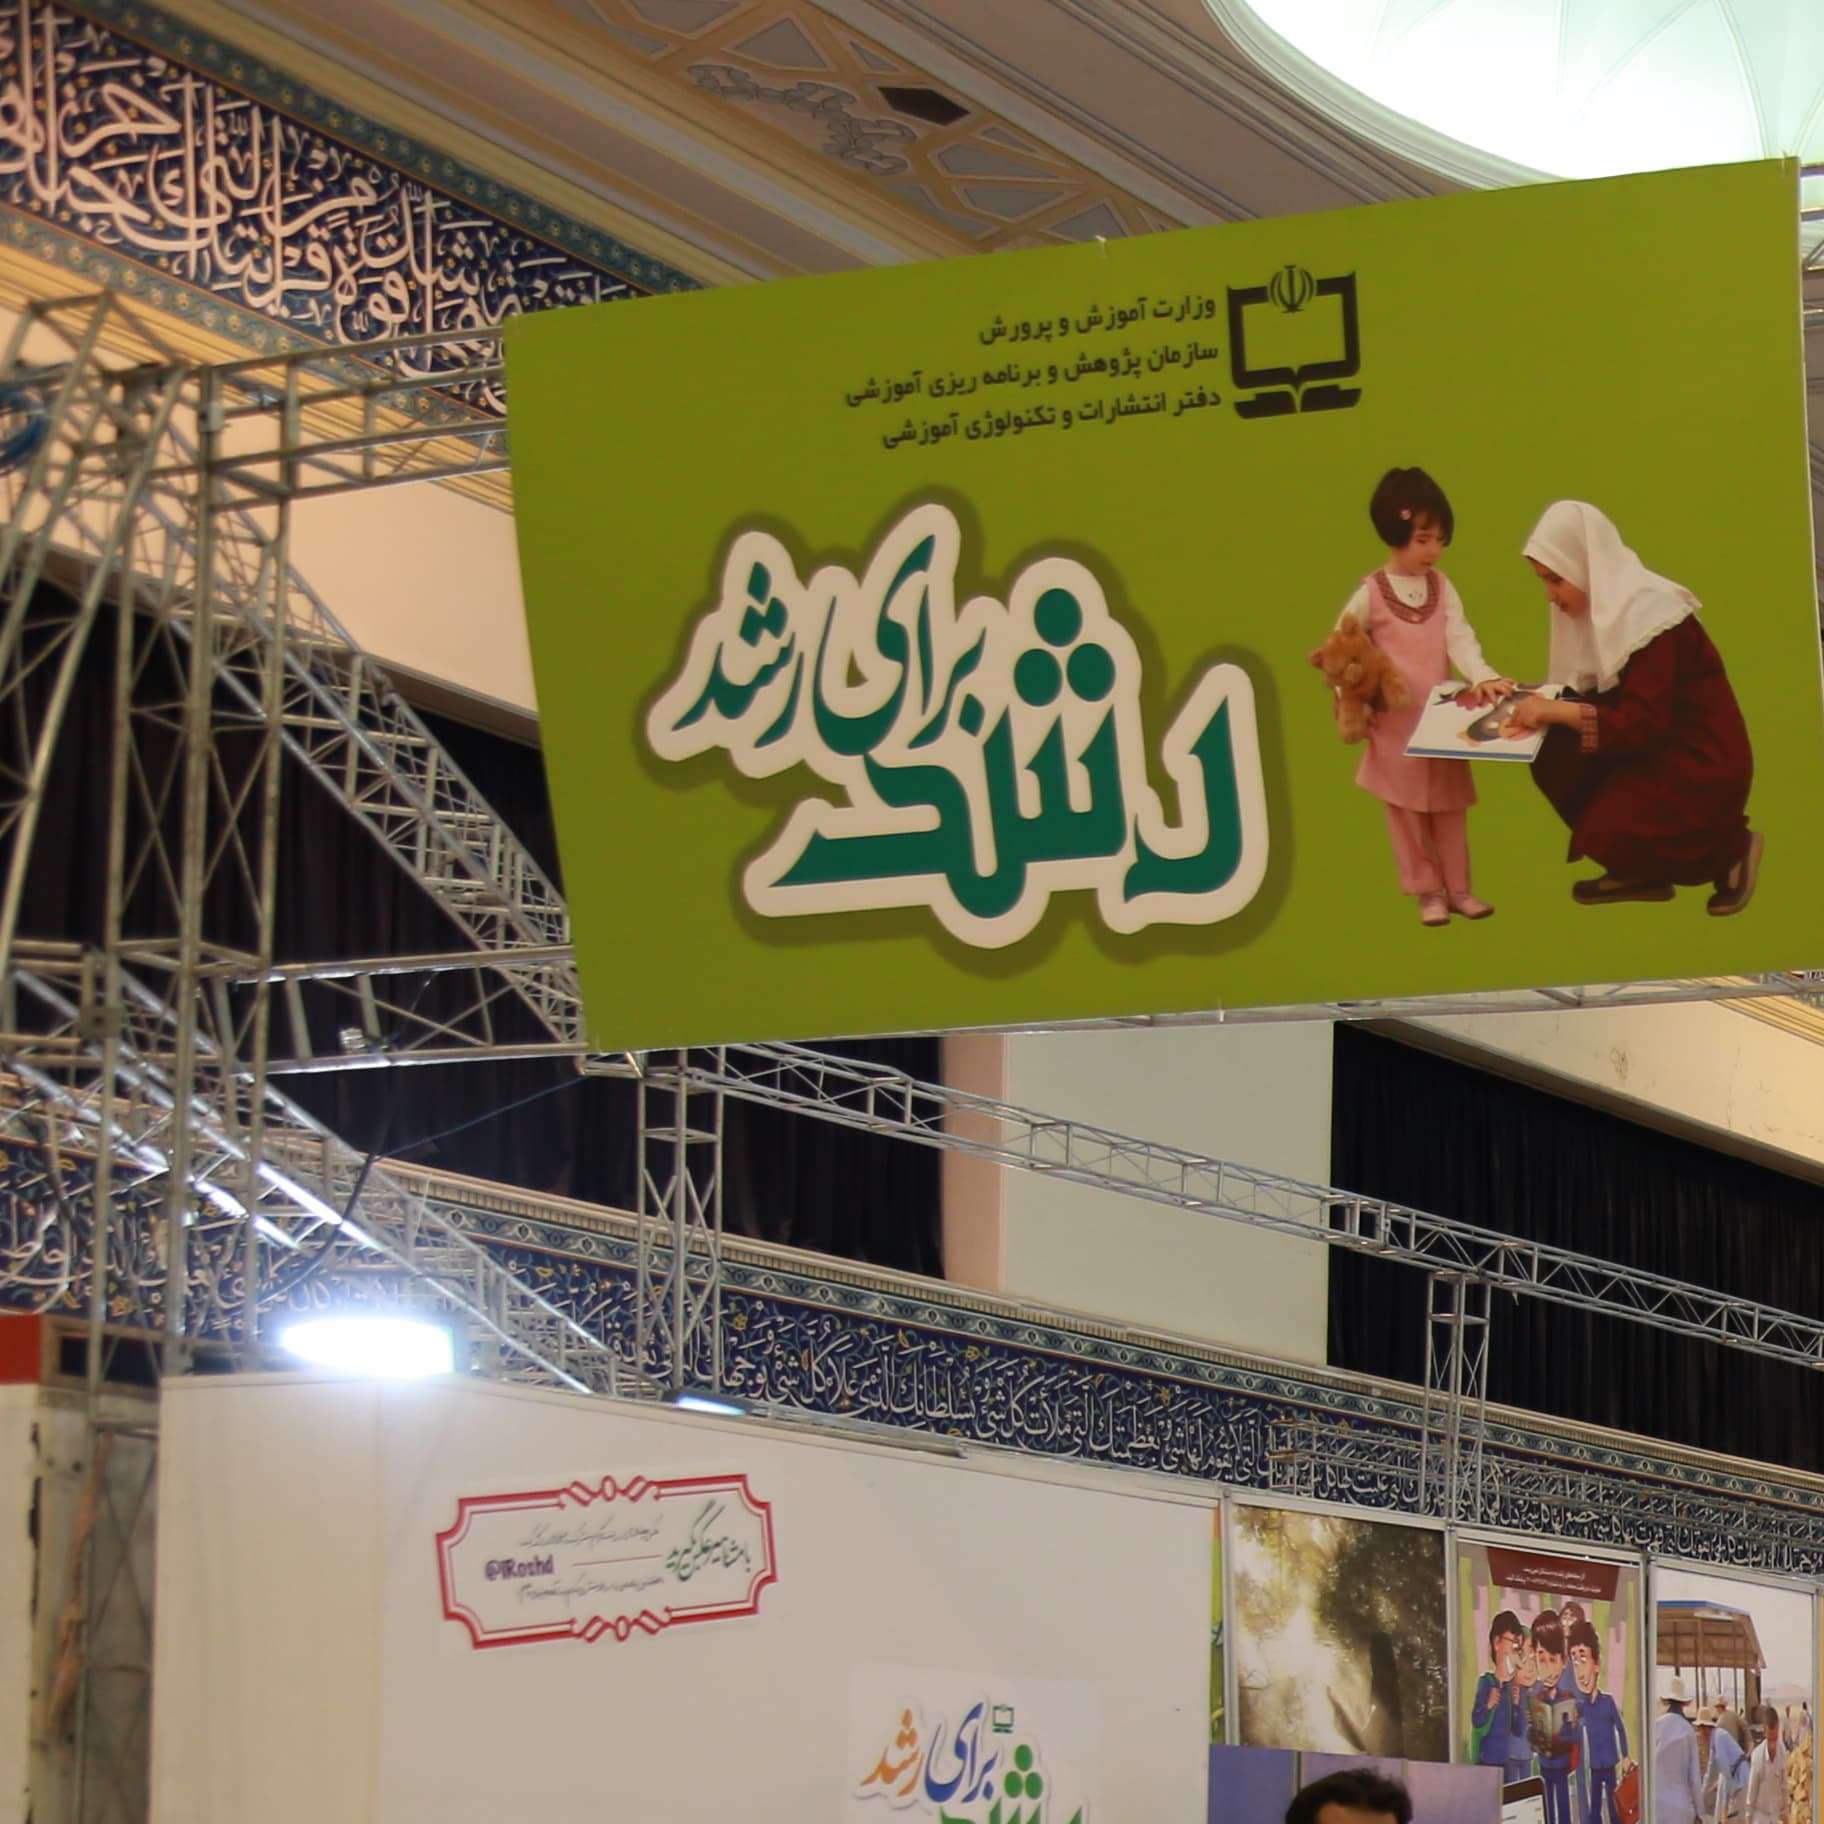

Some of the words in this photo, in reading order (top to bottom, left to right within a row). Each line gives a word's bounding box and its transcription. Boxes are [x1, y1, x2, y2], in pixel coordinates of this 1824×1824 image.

[1076, 297, 1148, 333] آموزش
[1152, 296, 1216, 321] وزارت
[978, 316, 1053, 345] پرورش
[1057, 317, 1070, 337] و
[1047, 364, 1059, 384] و
[1064, 349, 1142, 383] پژوهش
[1147, 341, 1219, 373] سازمان
[845, 370, 924, 408] آموزشی
[927, 373, 977, 402] ریزی
[982, 363, 1042, 389] برنامه
[1061, 409, 1074, 430] و
[1077, 389, 1168, 425] انتشارات
[1173, 387, 1223, 418] دفتر
[881, 412, 960, 450] آموزشی
[964, 404, 1056, 443] تکنولوژی
[672, 561, 804, 748] رشد
[813, 534, 987, 756] برای
[768, 588, 1243, 918] رشد
[860, 1709, 924, 1797] رشد
[924, 1703, 999, 1803] برای
